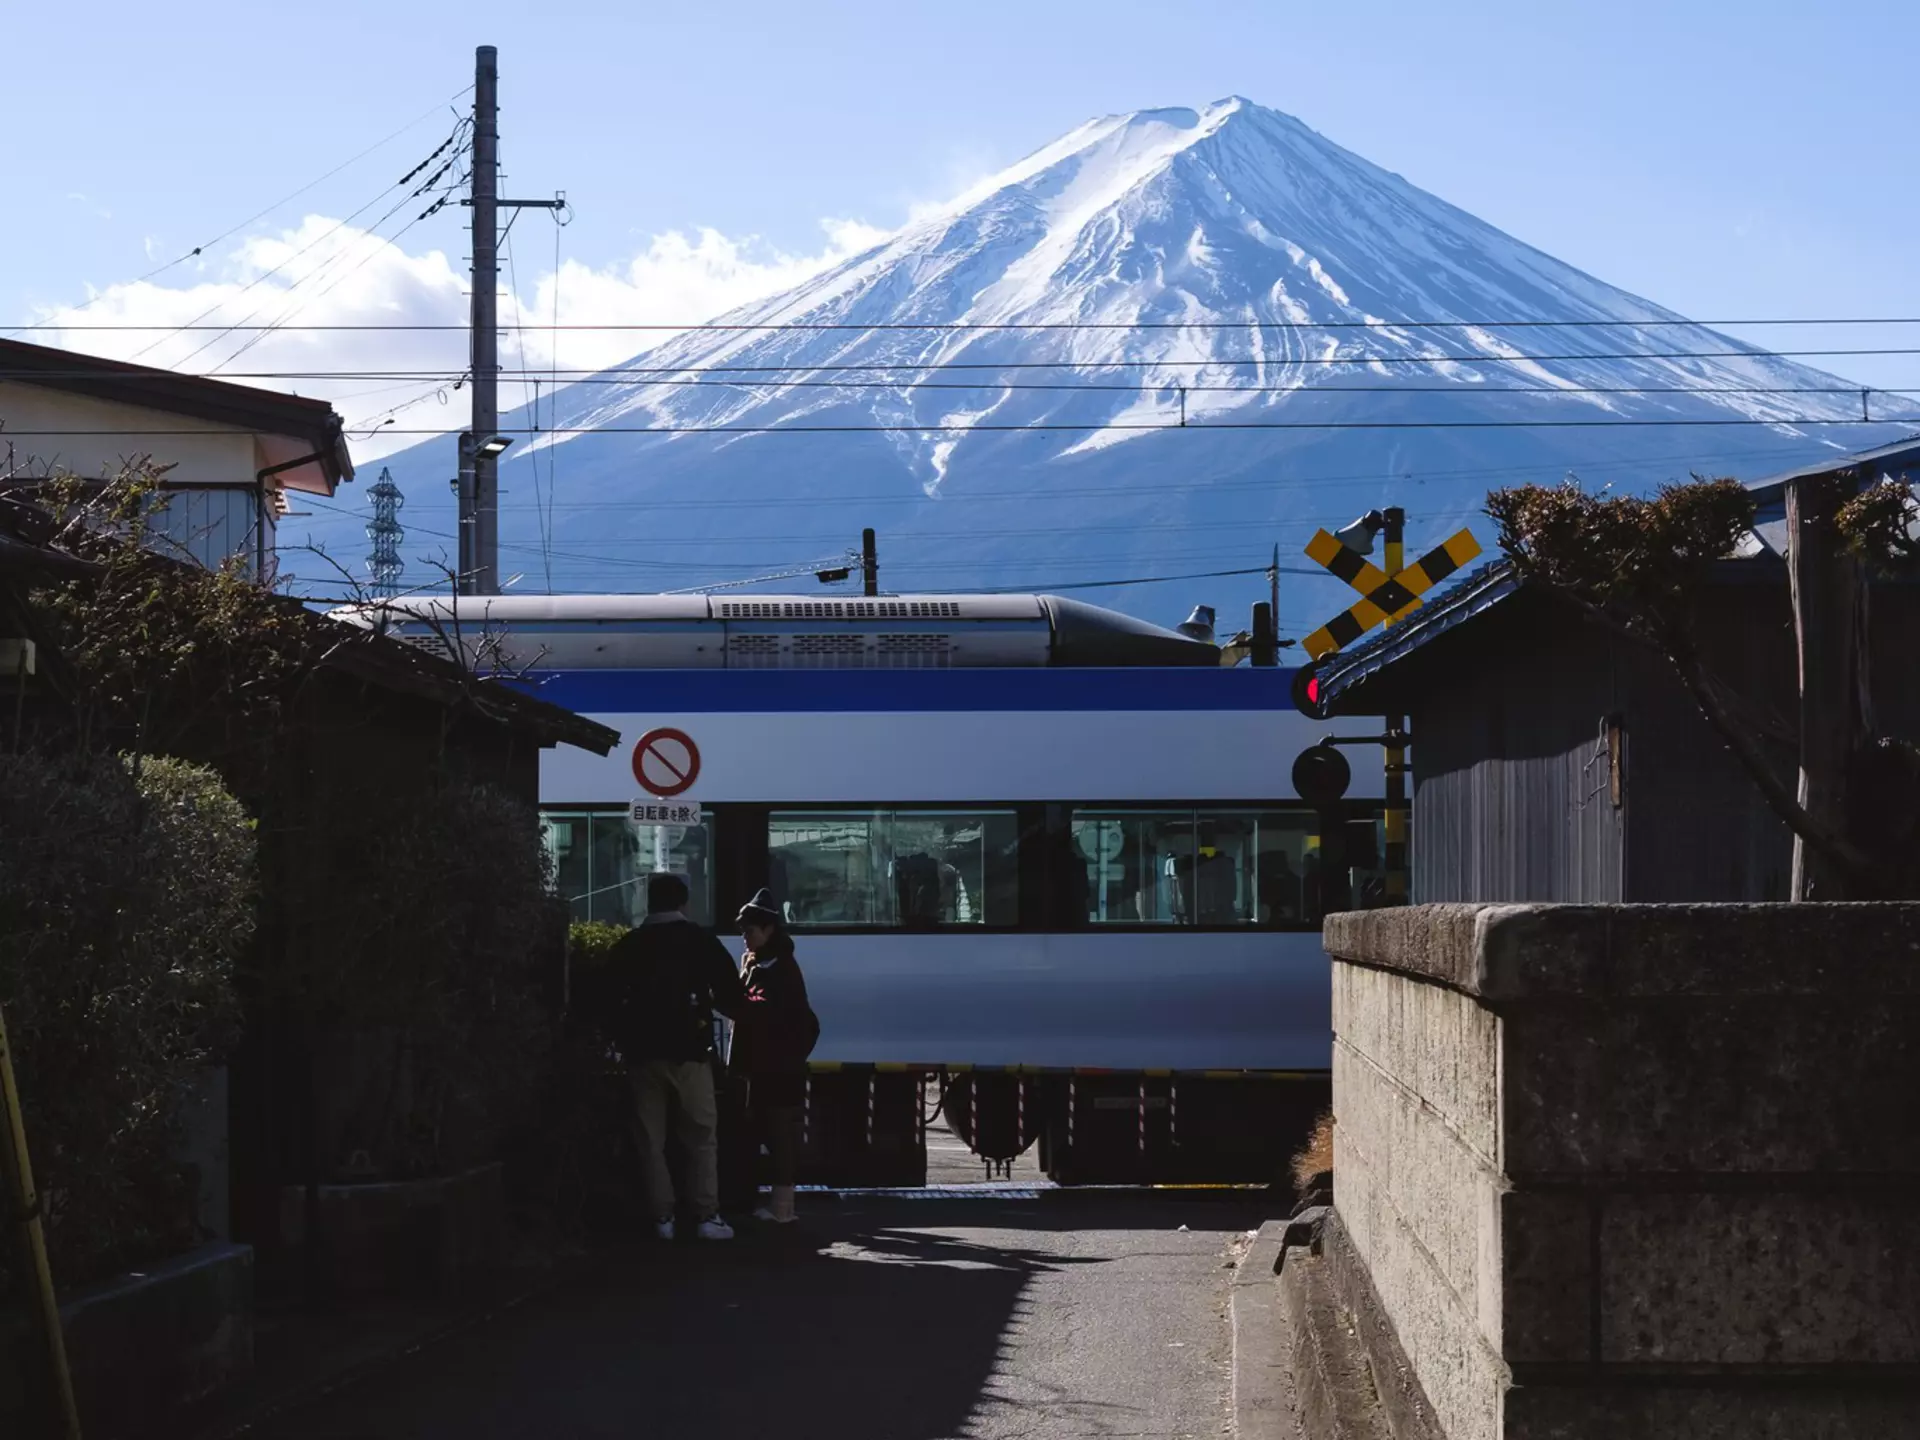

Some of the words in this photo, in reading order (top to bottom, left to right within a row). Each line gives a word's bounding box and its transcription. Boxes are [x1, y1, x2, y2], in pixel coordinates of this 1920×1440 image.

[634, 806, 698, 821] 自転車を除く
